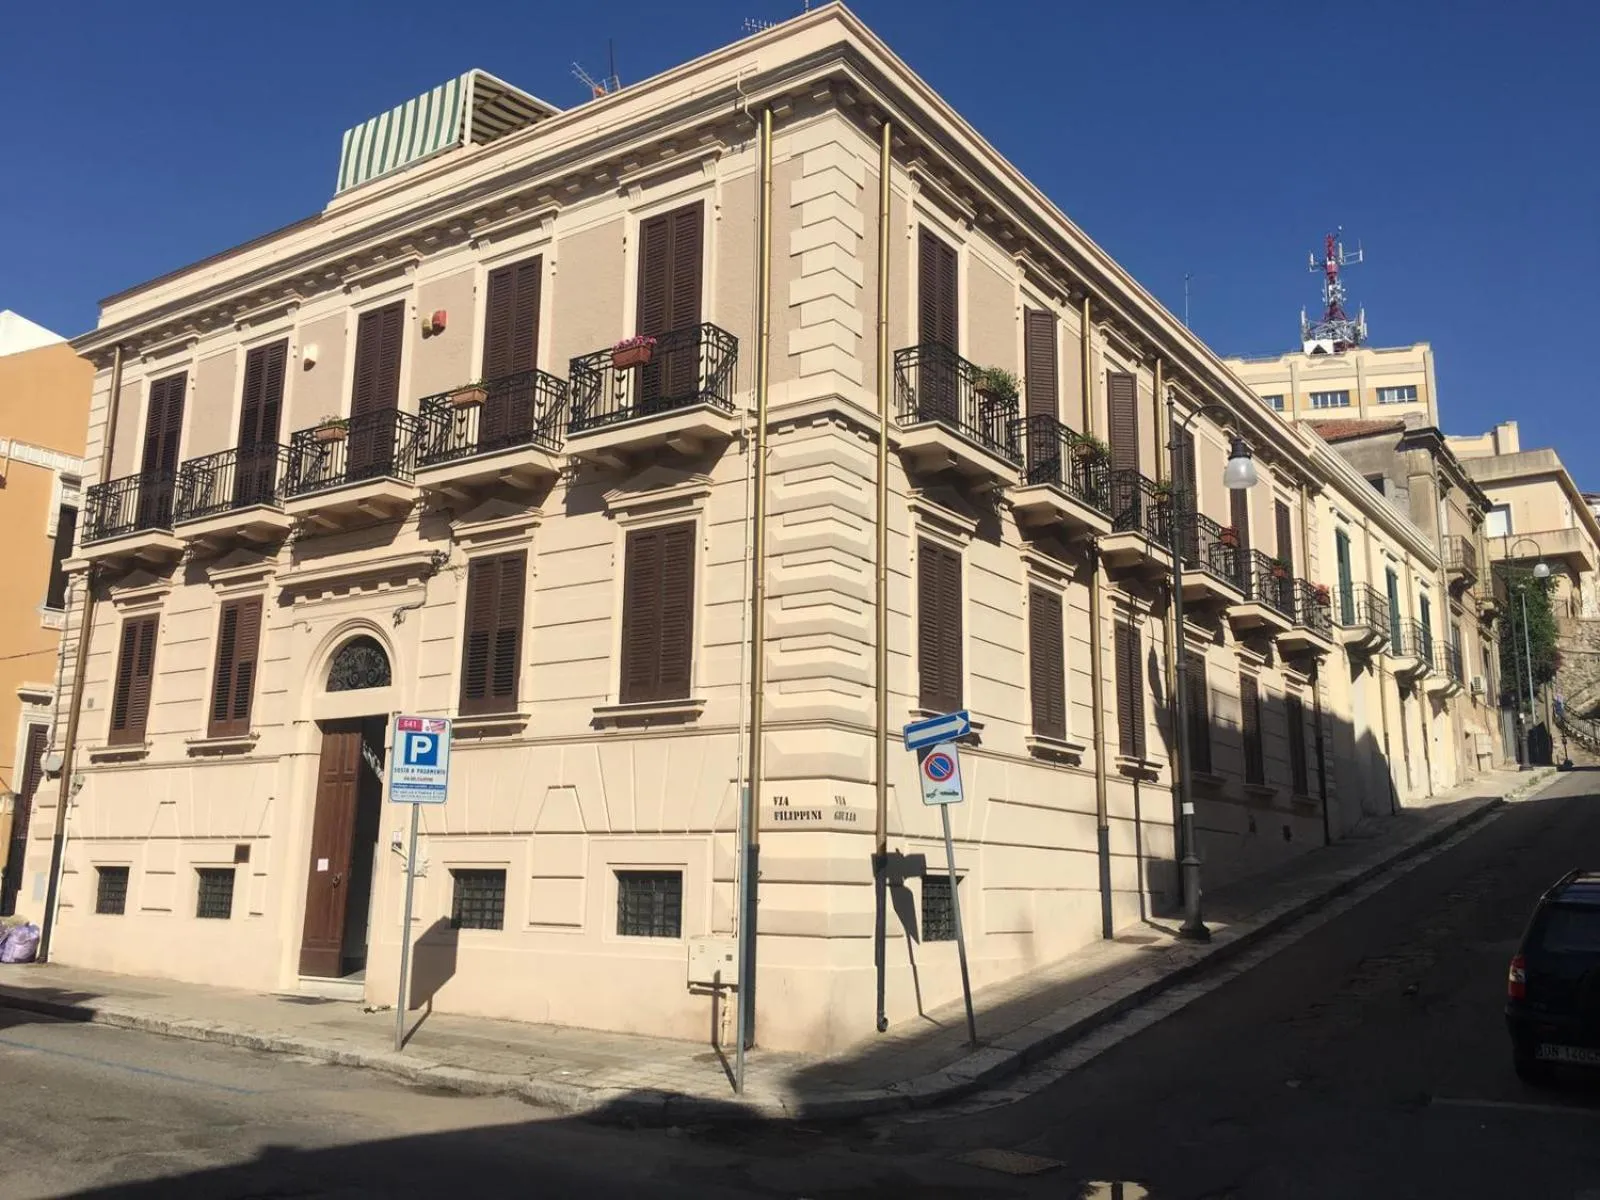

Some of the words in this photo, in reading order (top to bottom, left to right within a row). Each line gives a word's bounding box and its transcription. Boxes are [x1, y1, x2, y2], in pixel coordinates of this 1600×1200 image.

[410, 735, 433, 762] P
[773, 796, 789, 806] VIA
[834, 795, 846, 806] VIA
[774, 810, 822, 820] FILIPPINI
